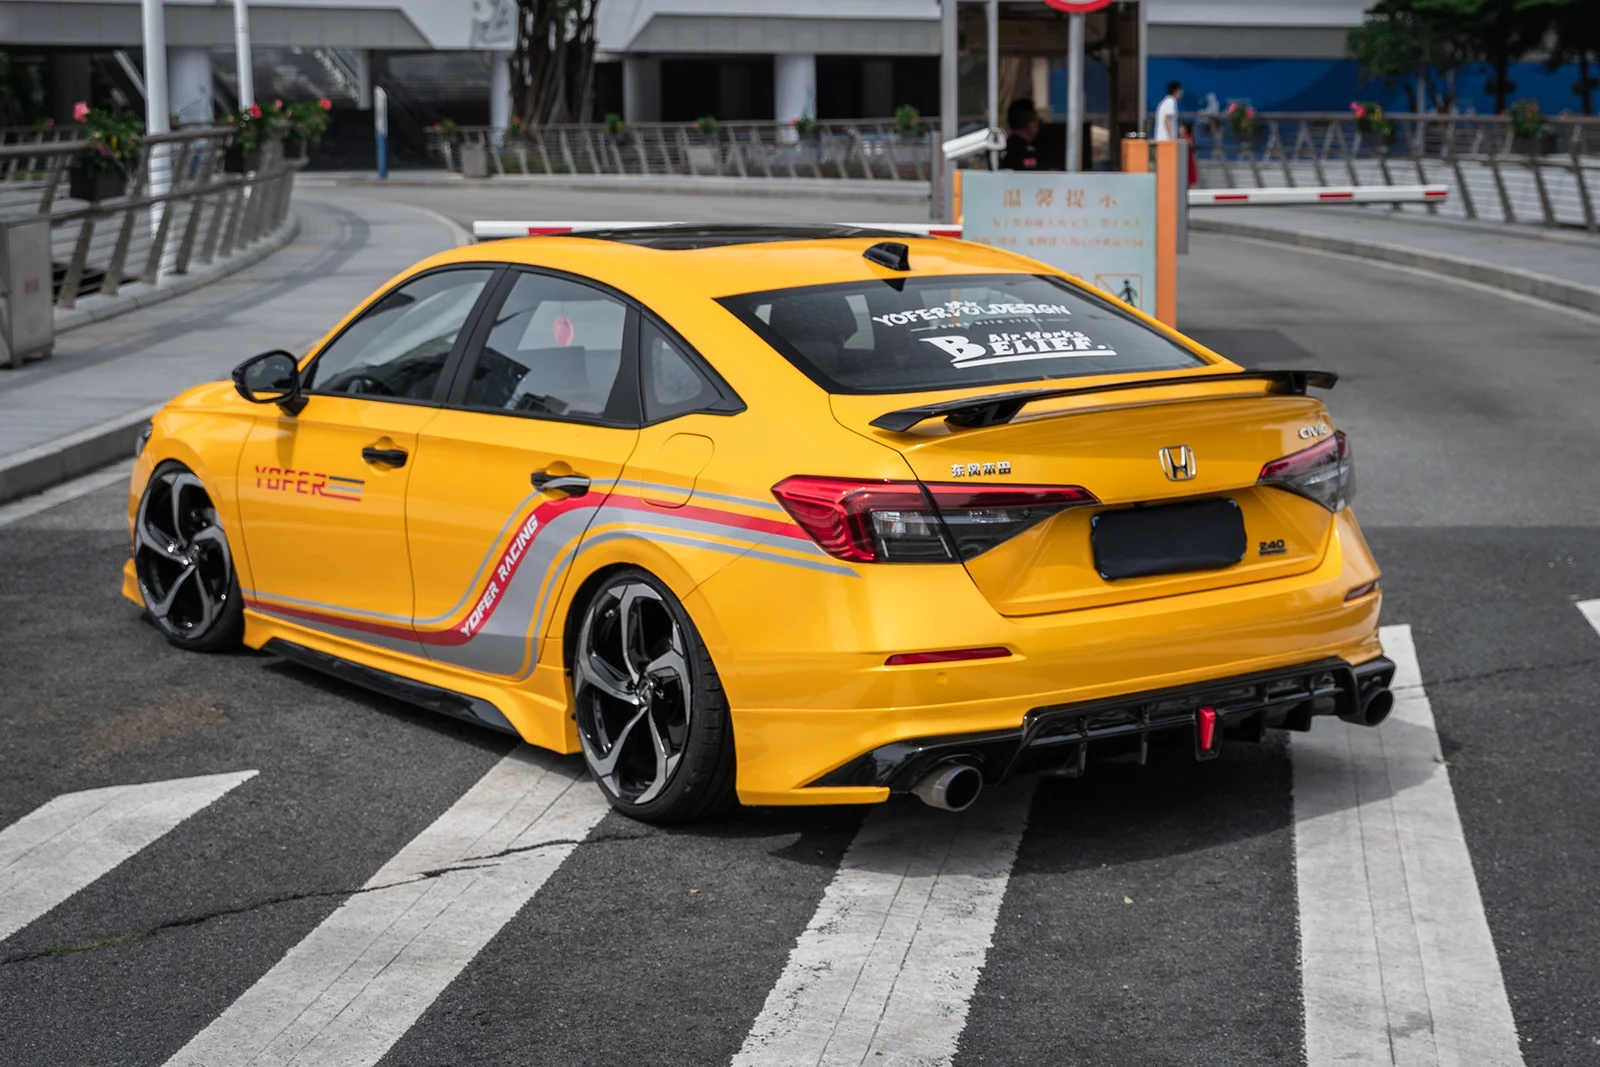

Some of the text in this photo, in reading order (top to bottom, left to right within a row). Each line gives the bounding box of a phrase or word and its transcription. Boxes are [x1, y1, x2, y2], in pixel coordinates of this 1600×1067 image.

[1299, 423, 1329, 439] CIVIC
[951, 461, 1011, 478] 东风本田
[255, 464, 328, 496] YOFER
[1259, 539, 1286, 551] 240
[460, 513, 539, 637] YOFER RACING
